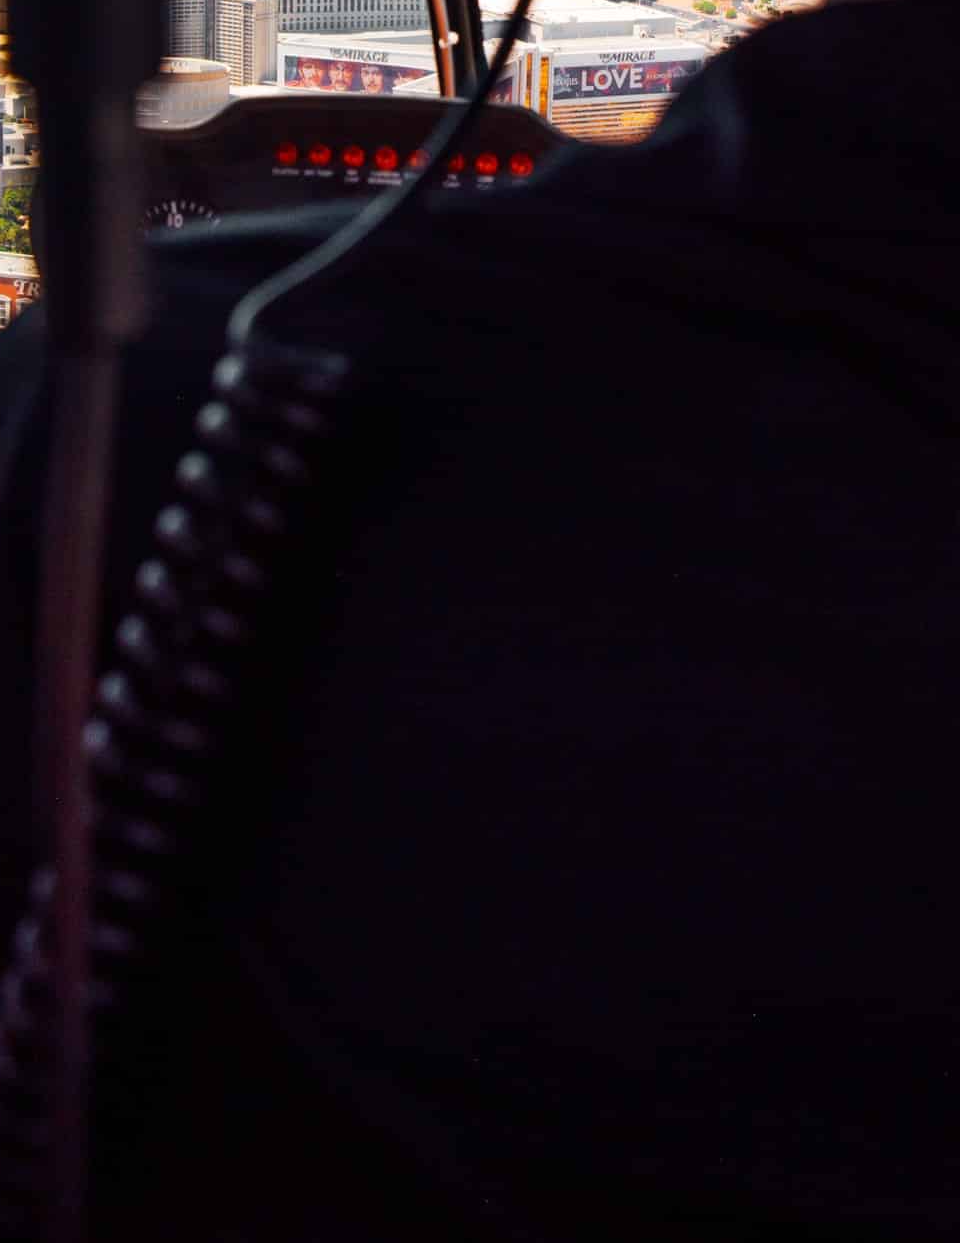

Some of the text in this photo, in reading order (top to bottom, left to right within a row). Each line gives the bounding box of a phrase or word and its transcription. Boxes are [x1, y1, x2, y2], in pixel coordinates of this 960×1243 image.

[341, 49, 389, 63] MIRAGE
[610, 50, 656, 62] MIRAGE
[581, 68, 643, 91] LOVE
